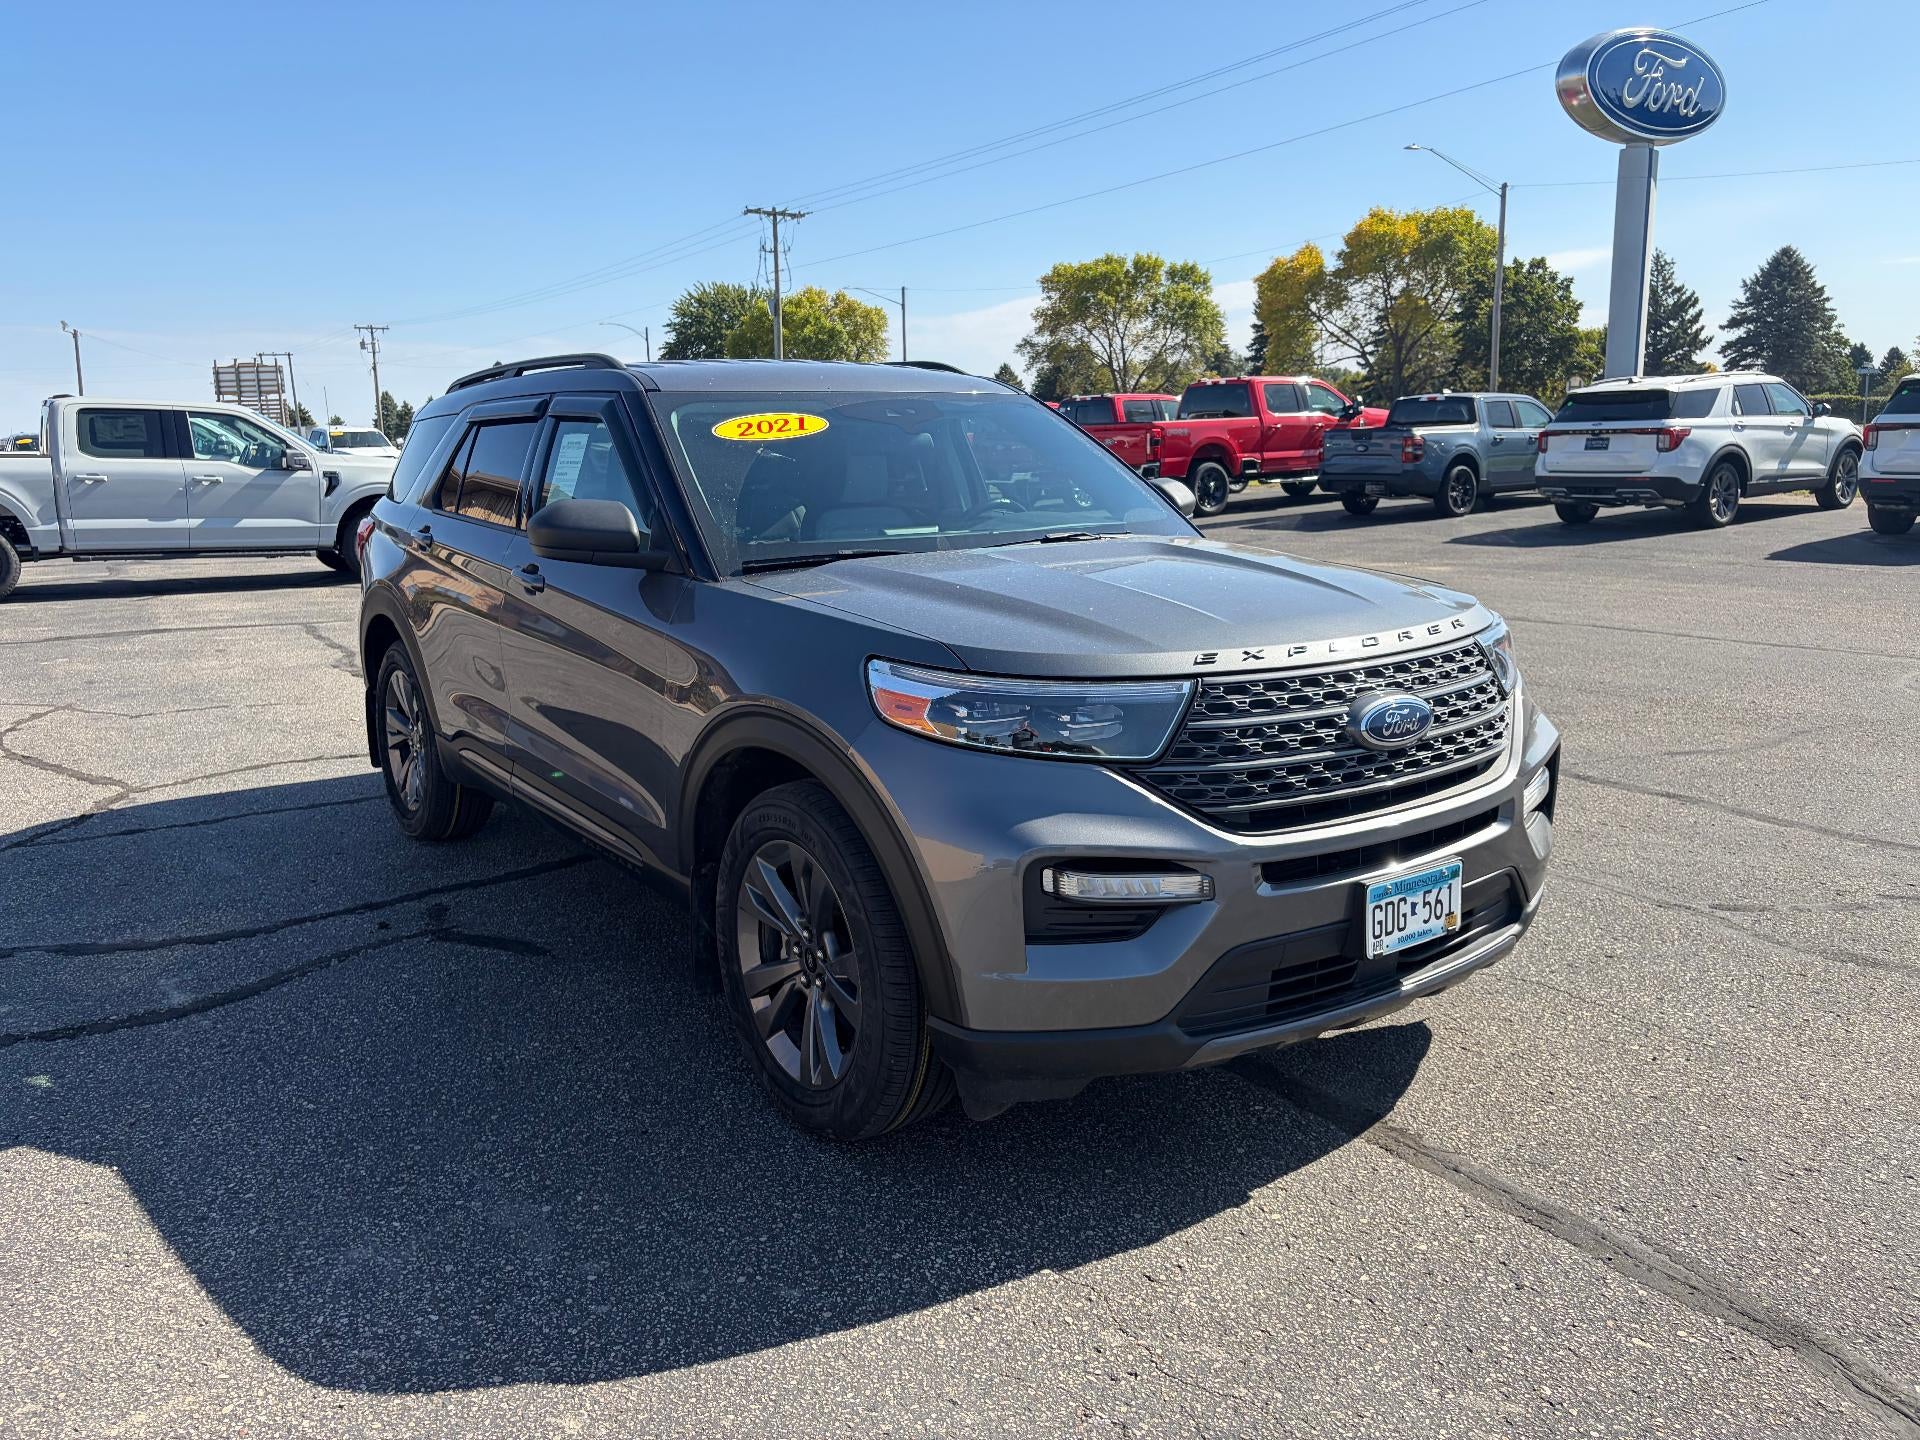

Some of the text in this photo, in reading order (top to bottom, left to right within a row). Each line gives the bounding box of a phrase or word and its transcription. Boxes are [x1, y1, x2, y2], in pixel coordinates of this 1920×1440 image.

[1623, 49, 1705, 117] Ford
[736, 417, 808, 436] 2021
[1194, 618, 1465, 664] EXPLORER
[1383, 708, 1421, 736] Ford
[1373, 883, 1454, 939] GDG 561
[1397, 934, 1416, 944] 10,000
